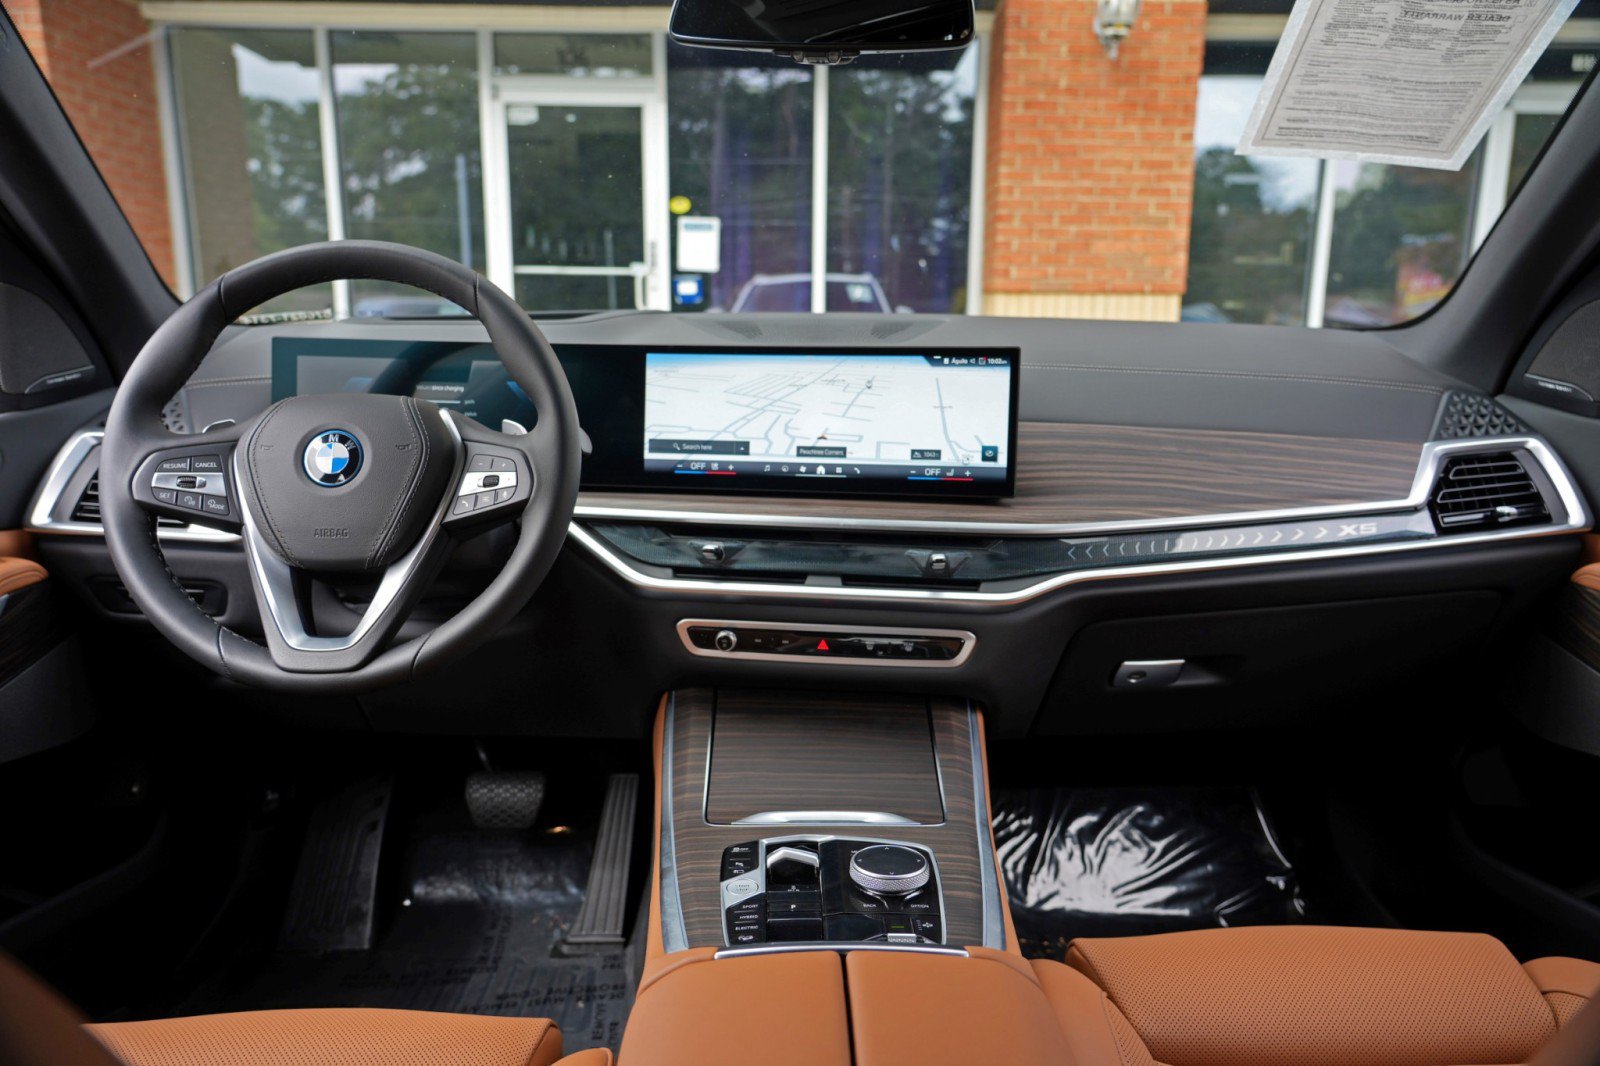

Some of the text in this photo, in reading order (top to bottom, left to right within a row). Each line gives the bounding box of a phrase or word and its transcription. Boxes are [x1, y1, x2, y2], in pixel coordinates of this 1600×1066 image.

[162, 462, 188, 470] RESUME
[690, 462, 706, 470] OFF
[925, 468, 941, 476] OFF
[209, 503, 225, 511] MODE
[314, 528, 349, 538] AIRBAG
